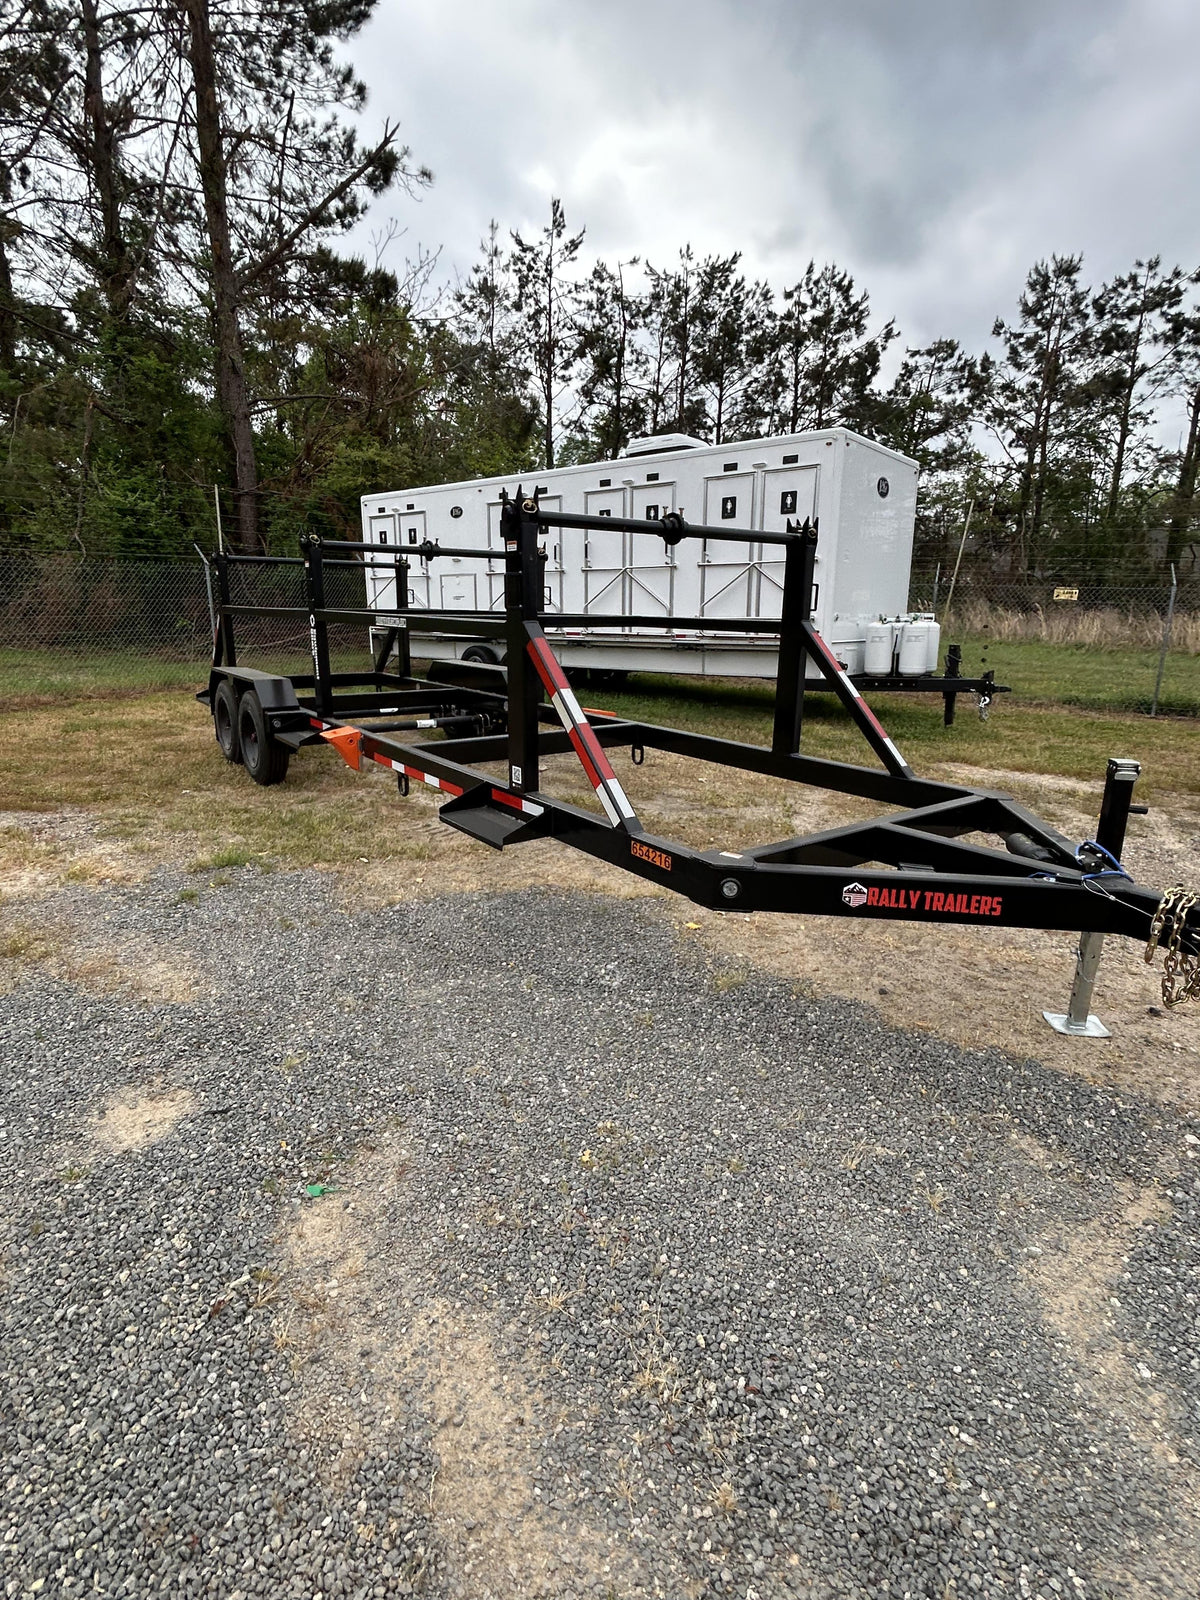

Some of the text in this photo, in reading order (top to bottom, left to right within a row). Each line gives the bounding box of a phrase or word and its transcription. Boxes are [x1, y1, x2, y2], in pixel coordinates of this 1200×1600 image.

[632, 842, 670, 869] 654216
[867, 887, 1003, 916] RALLY TRAILERS
